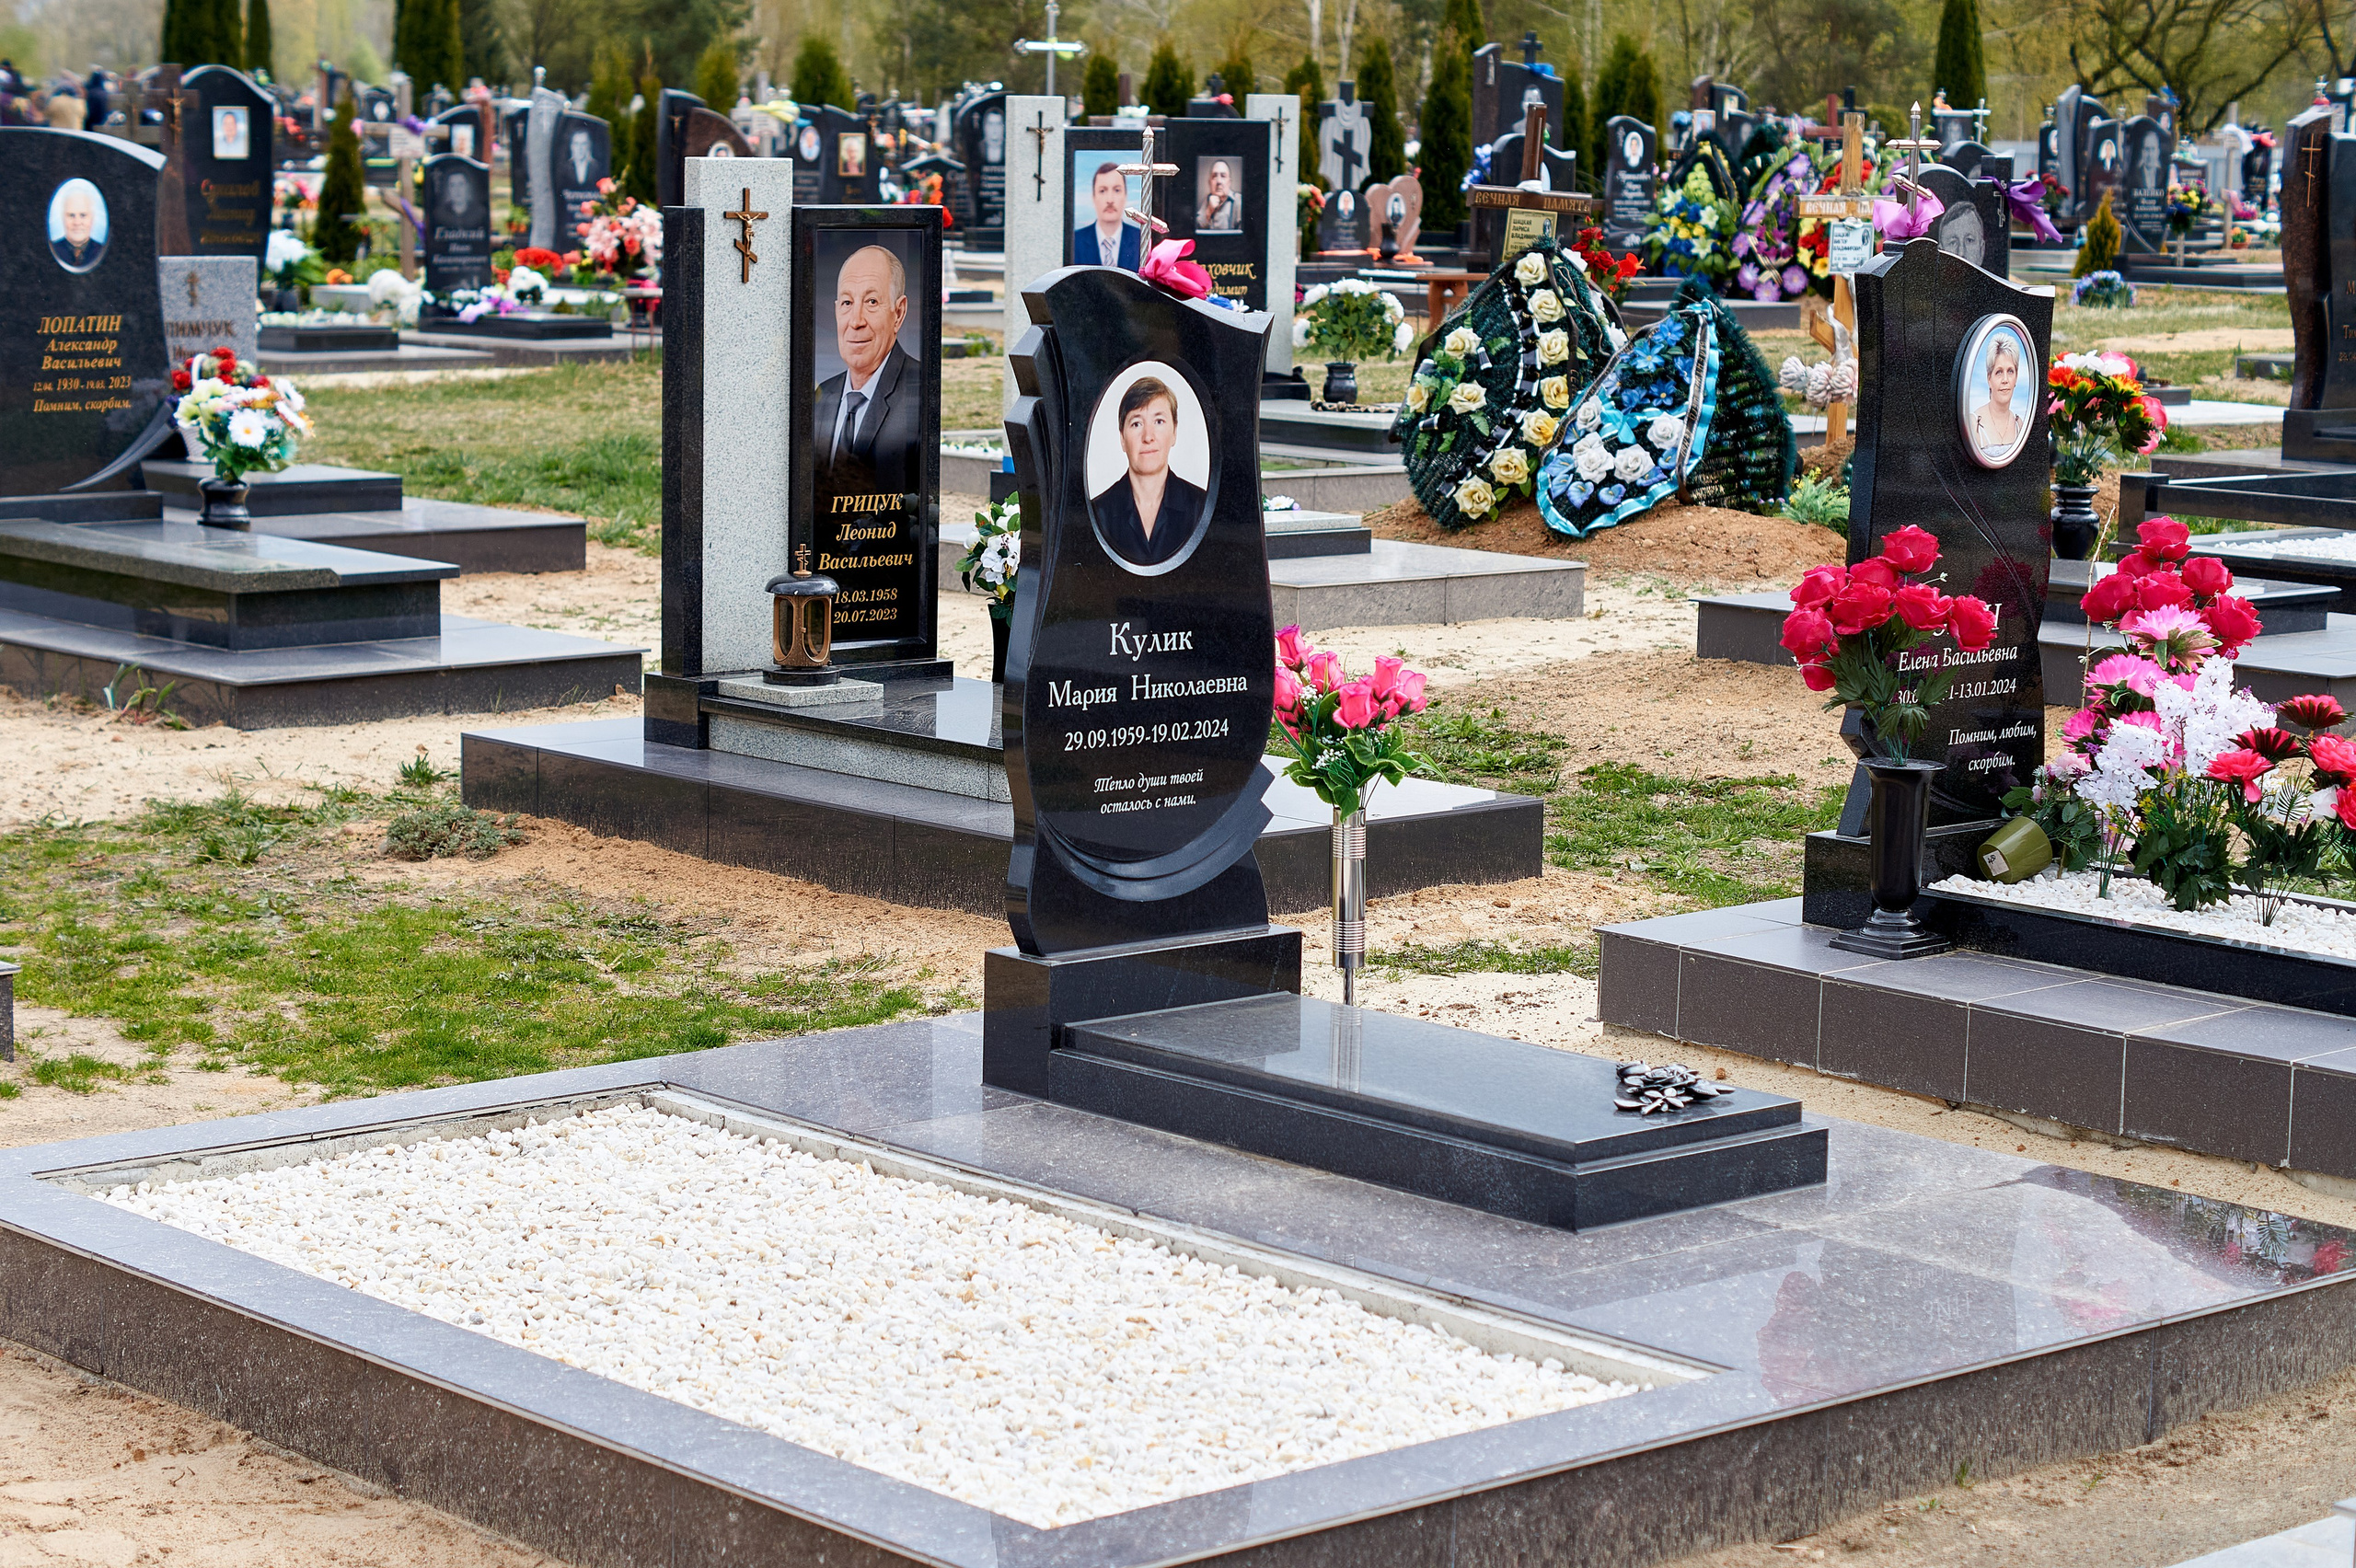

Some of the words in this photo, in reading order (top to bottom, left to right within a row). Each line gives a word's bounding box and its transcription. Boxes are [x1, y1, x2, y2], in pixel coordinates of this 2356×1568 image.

[1474, 190, 1520, 207] ВЕЧНАЯ
[1543, 197, 1589, 212] ПАМЯТЬ
[1806, 201, 1846, 214] ВЕЧНАЯ
[1512, 218, 1532, 226] ШАЦКАЯ
[37, 315, 122, 334] ЛОПАТИН
[45, 337, 118, 354] Александр
[41, 355, 121, 370] Васильевич
[56, 377, 79, 391] 1930
[109, 375, 132, 389] 2023
[33, 398, 83, 413] Помним,
[85, 397, 132, 413] скорбим.
[830, 492, 904, 515] ГРИЦУК
[836, 521, 897, 541] Леонид
[817, 552, 914, 571] Васильевич
[834, 587, 898, 605] 18.03.1958
[833, 607, 898, 624] 20.07.2023
[1109, 621, 1193, 662] Кулик
[1898, 651, 1939, 672] Елена
[1942, 646, 2018, 668] Васильевна
[1048, 679, 1117, 711] Мария
[1131, 674, 1248, 701] Николаевна
[1064, 718, 1230, 752] 29.09.1959-19.02.2024
[1947, 729, 1997, 746] Помним,
[1999, 721, 2037, 740] любим,
[1968, 751, 2015, 775] скорбим.
[1093, 775, 1135, 793] Тепло
[1138, 772, 1167, 793] души
[1170, 768, 1204, 783] твоей
[1100, 799, 1152, 814] осталось
[1155, 799, 1161, 808] с
[1164, 792, 1197, 808] нами.
